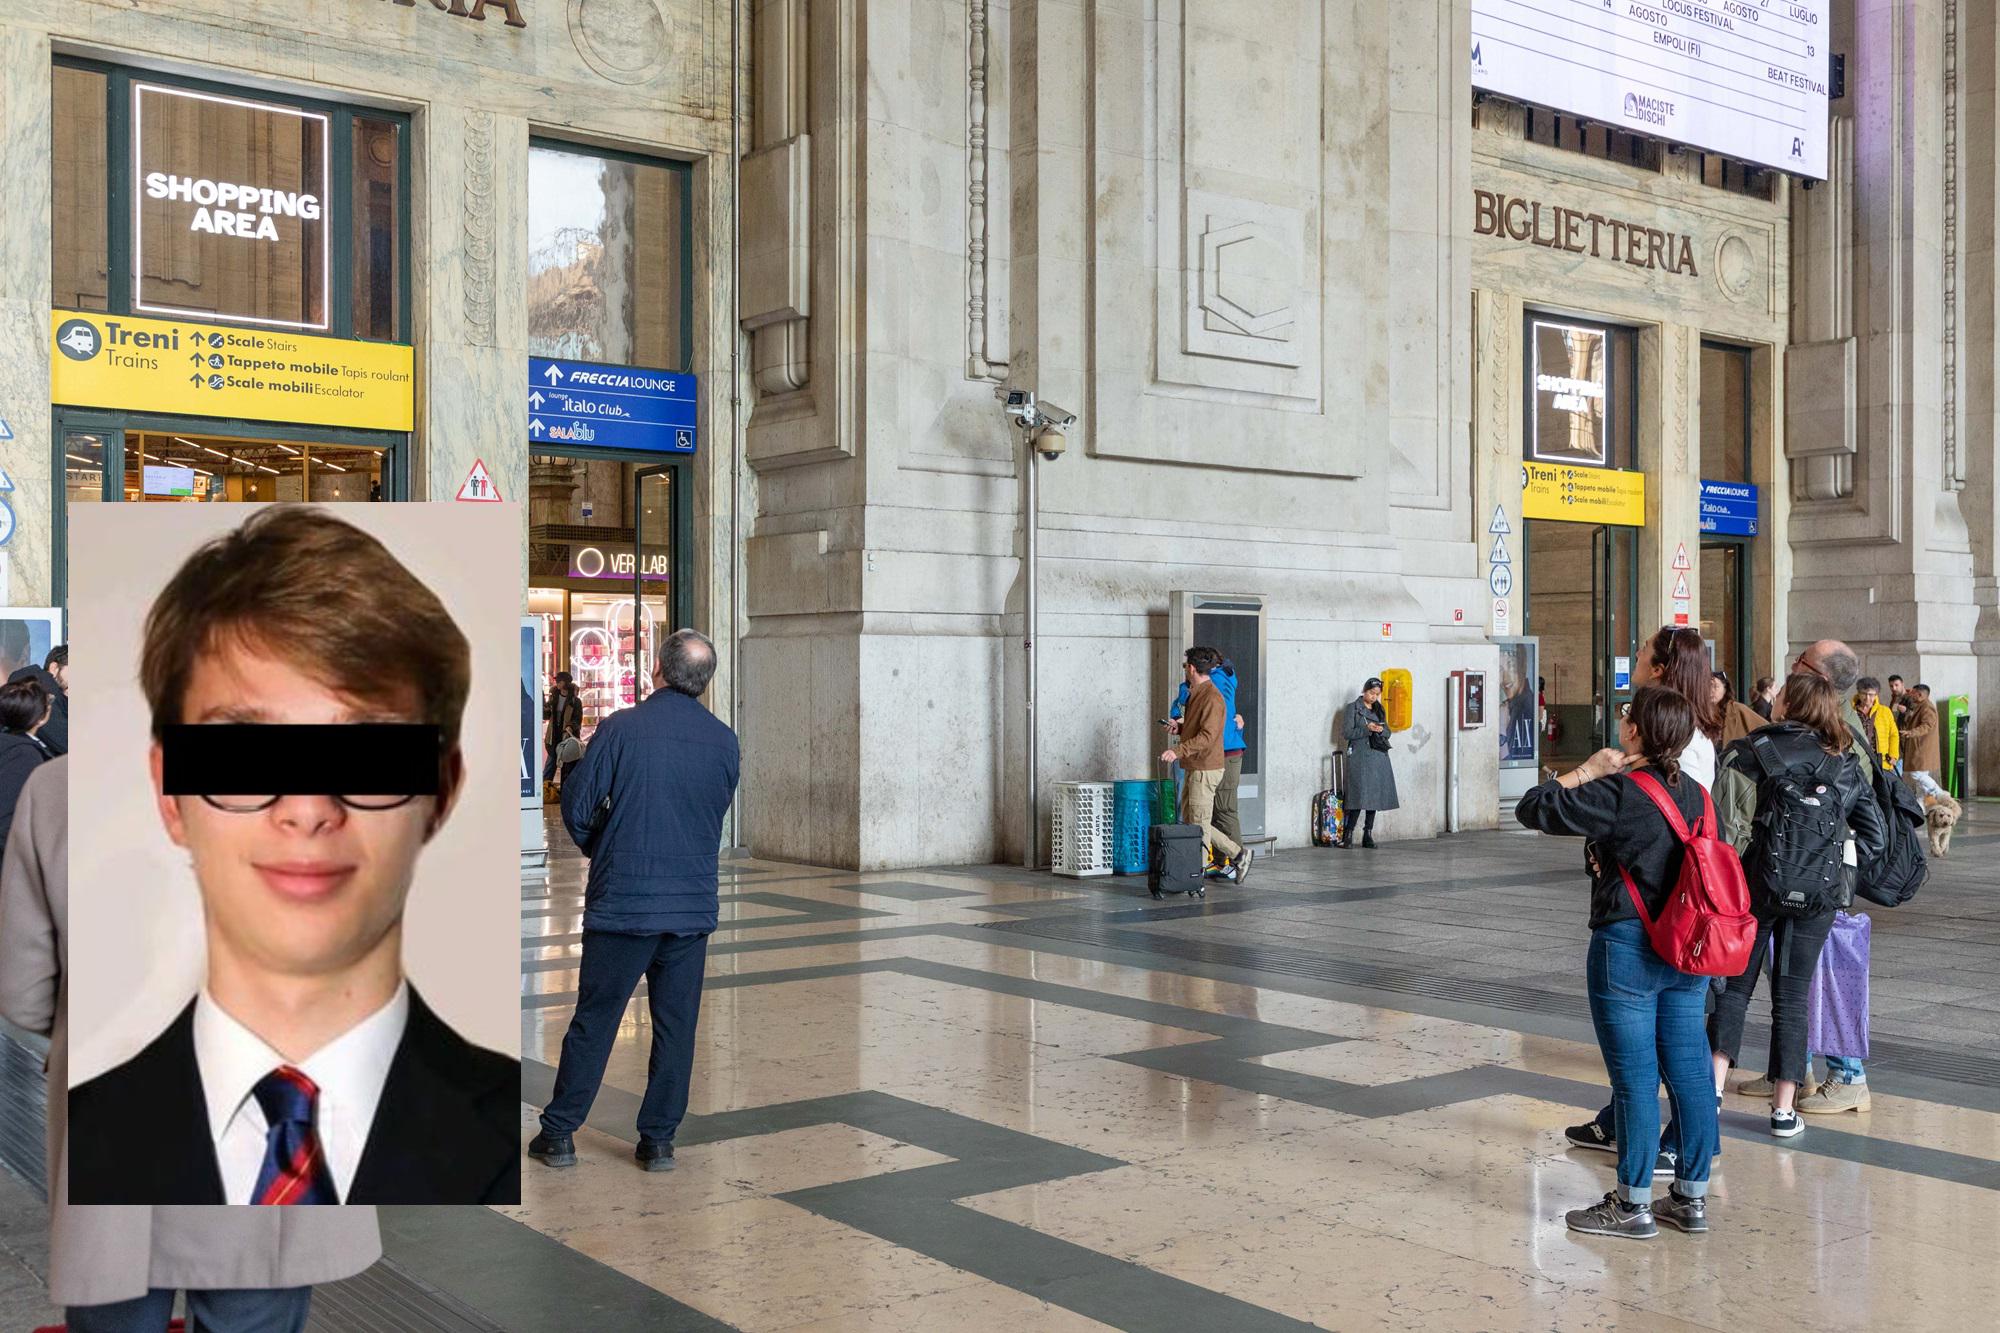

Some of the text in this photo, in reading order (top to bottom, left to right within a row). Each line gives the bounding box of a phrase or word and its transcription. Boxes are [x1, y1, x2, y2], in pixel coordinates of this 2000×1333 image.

[1629, 4, 1667, 26] AGOSTO
[1663, 0, 1734, 30] LOCUS FESTIVAL
[1724, 1, 1759, 21] AGOSTO
[1790, 6, 1817, 24] LUGLIO
[1653, 31, 1701, 57] EMPOLI (FI)
[1807, 45, 1815, 57] 13
[1768, 67, 1827, 95] BEAT FESTIVAL
[1638, 95, 1674, 116] MACISTE
[1638, 109, 1666, 126] DISCHI
[146, 172, 320, 220] SHOPPING
[191, 207, 279, 241] AREA
[1473, 189, 1698, 277] BIGLIETTERIA
[105, 322, 179, 350] Treni
[227, 334, 297, 352] Scale Stairs
[105, 349, 158, 370] Trains
[227, 355, 409, 383] Tappeto mobile Tapis roulant
[227, 375, 365, 399] Scale mobili Escalator
[549, 392, 569, 400] lounge
[598, 403, 622, 416] Club
[1530, 466, 1557, 481] Treni
[1530, 482, 1550, 494] Trains
[610, 553, 667, 575] VERLAB
